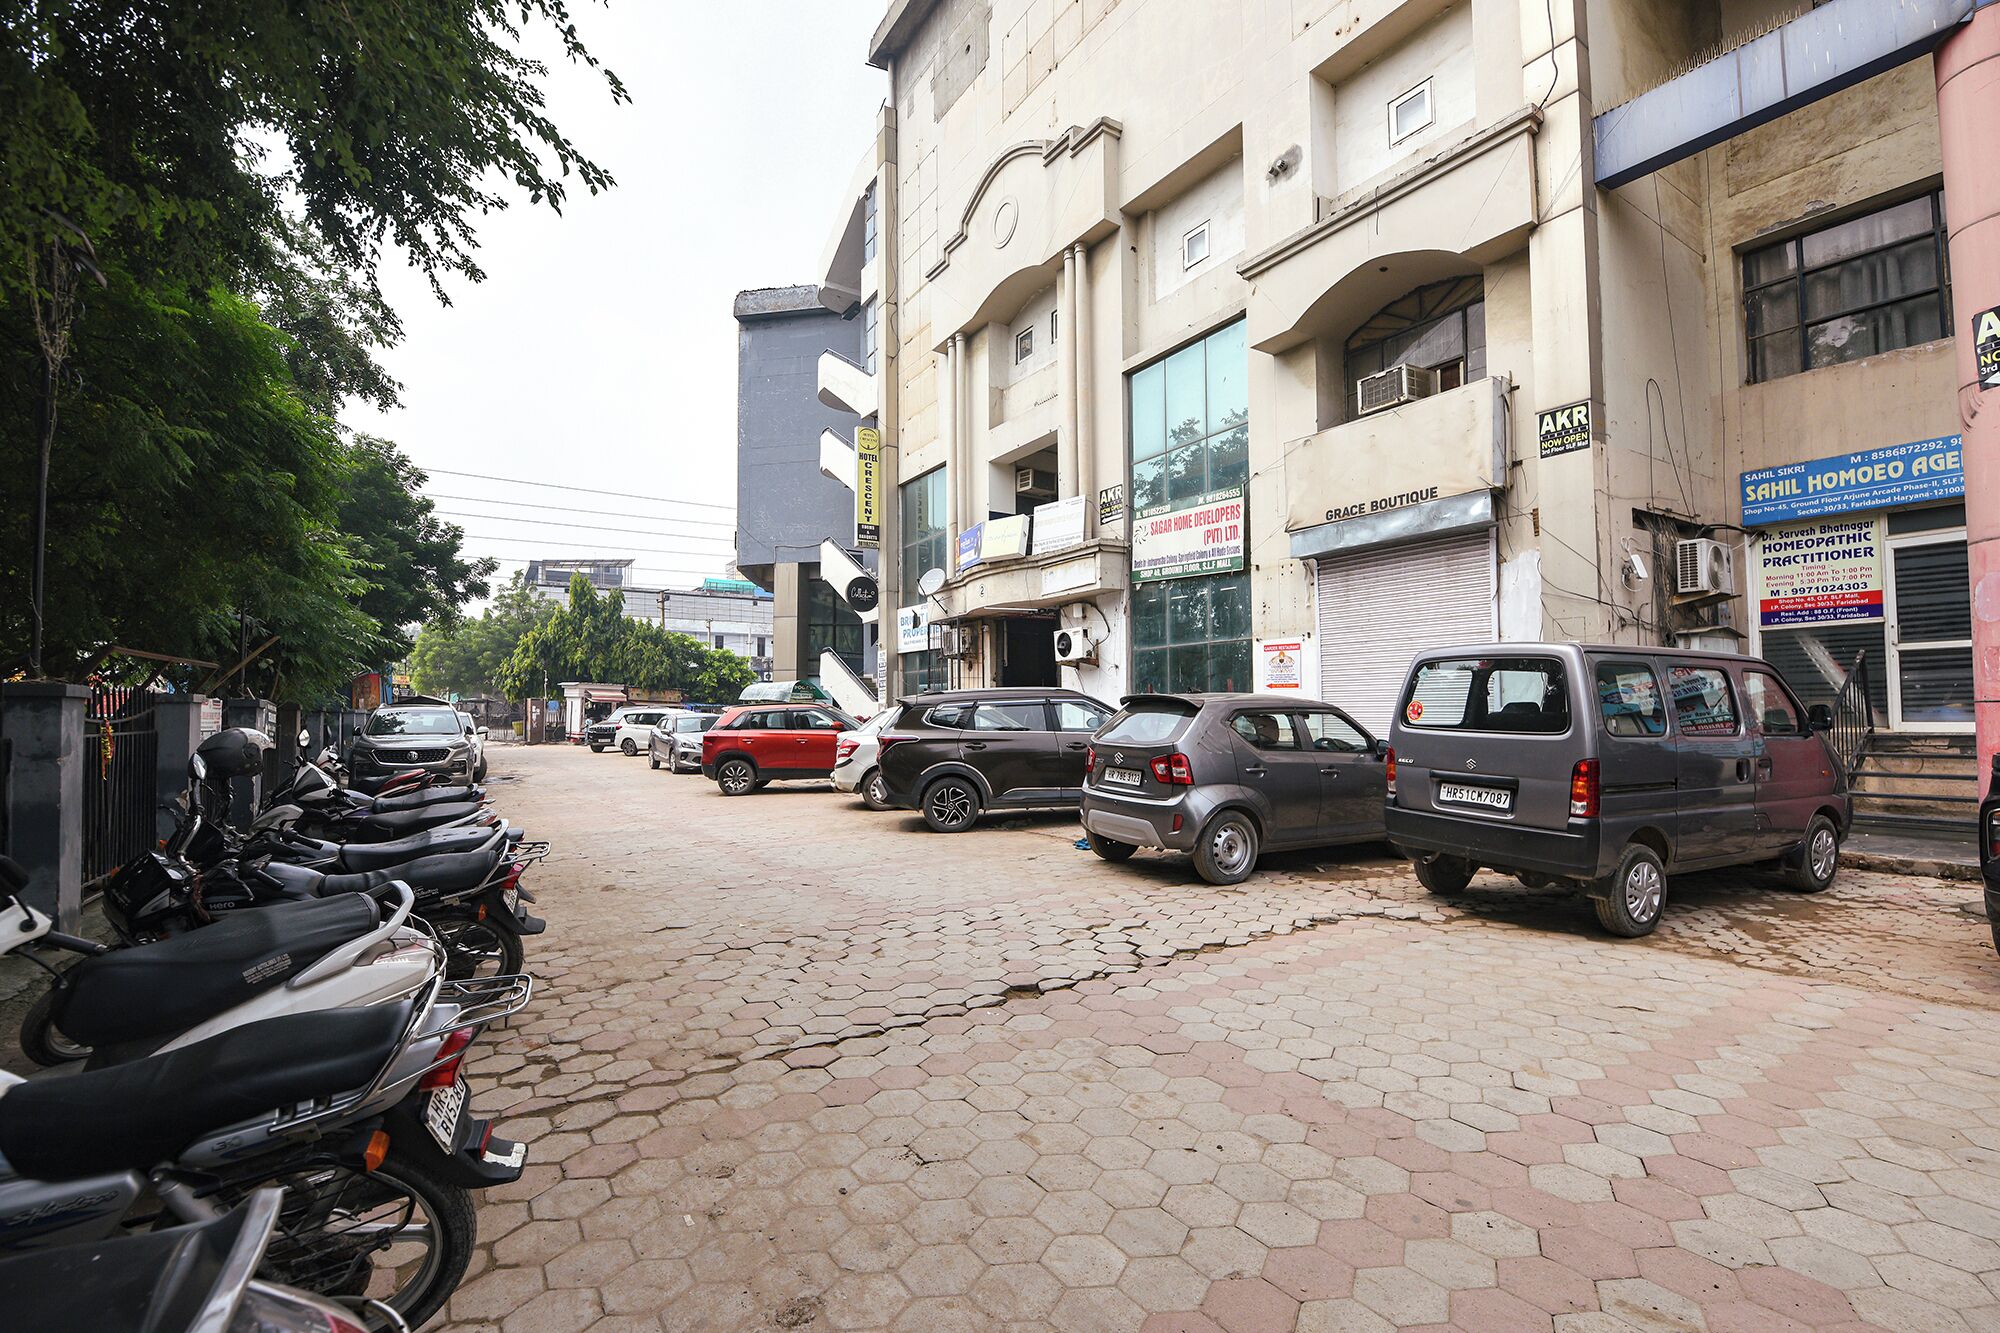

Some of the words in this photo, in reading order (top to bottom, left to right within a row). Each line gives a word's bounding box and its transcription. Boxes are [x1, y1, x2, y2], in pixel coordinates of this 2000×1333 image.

[1981, 364, 1998, 375] 3rd
[1540, 405, 1588, 435] AKR
[1541, 438, 1562, 449] NOW
[1563, 432, 1588, 444] OPEN
[859, 452, 878, 462] HOTEL
[1850, 456, 1861, 464] M
[1745, 471, 1776, 482] SAHIL
[1777, 465, 1806, 476] SIKRI
[1745, 478, 1802, 501] SAHIL
[1807, 460, 1904, 494] HOMOEO
[1911, 451, 1964, 477] AGE
[864, 462, 873, 522] CRESCENT
[1100, 486, 1122, 504] AKR
[1744, 506, 1762, 515] Shop
[1790, 498, 1819, 508] Ground
[1821, 496, 1841, 504] Floor
[1843, 491, 1870, 501] Arjune
[1871, 486, 1902, 496] Arcade
[1942, 477, 1958, 485] SLF
[1325, 503, 1366, 521] GRACE
[1370, 486, 1438, 513] BOUTIQUE
[1850, 495, 1892, 508] Faridabad
[1150, 518, 1172, 536] SAGAR
[1173, 513, 1193, 532] HOME
[1194, 504, 1241, 527] DEVELOPERS
[1203, 527, 1223, 546] (PVT)
[1225, 524, 1240, 541] LTD.
[1778, 527, 1816, 539] Sarvesh
[1819, 520, 1875, 534] Bhatnagar
[1762, 531, 1872, 555] HOMEOPATHIC
[1762, 546, 1875, 568] PRACTITIONER
[1140, 569, 1154, 578] SHOP
[1161, 565, 1183, 575] GROUND
[1216, 558, 1232, 569] MALL
[1801, 564, 1826, 572] Timing
[1765, 573, 1794, 581] Morning
[1765, 580, 1794, 588] Evening
[1770, 589, 1780, 597] M
[1791, 581, 1869, 596] 9971024303
[1836, 598, 1869, 606] Faridabad
[1836, 611, 1869, 619] Faridabad
